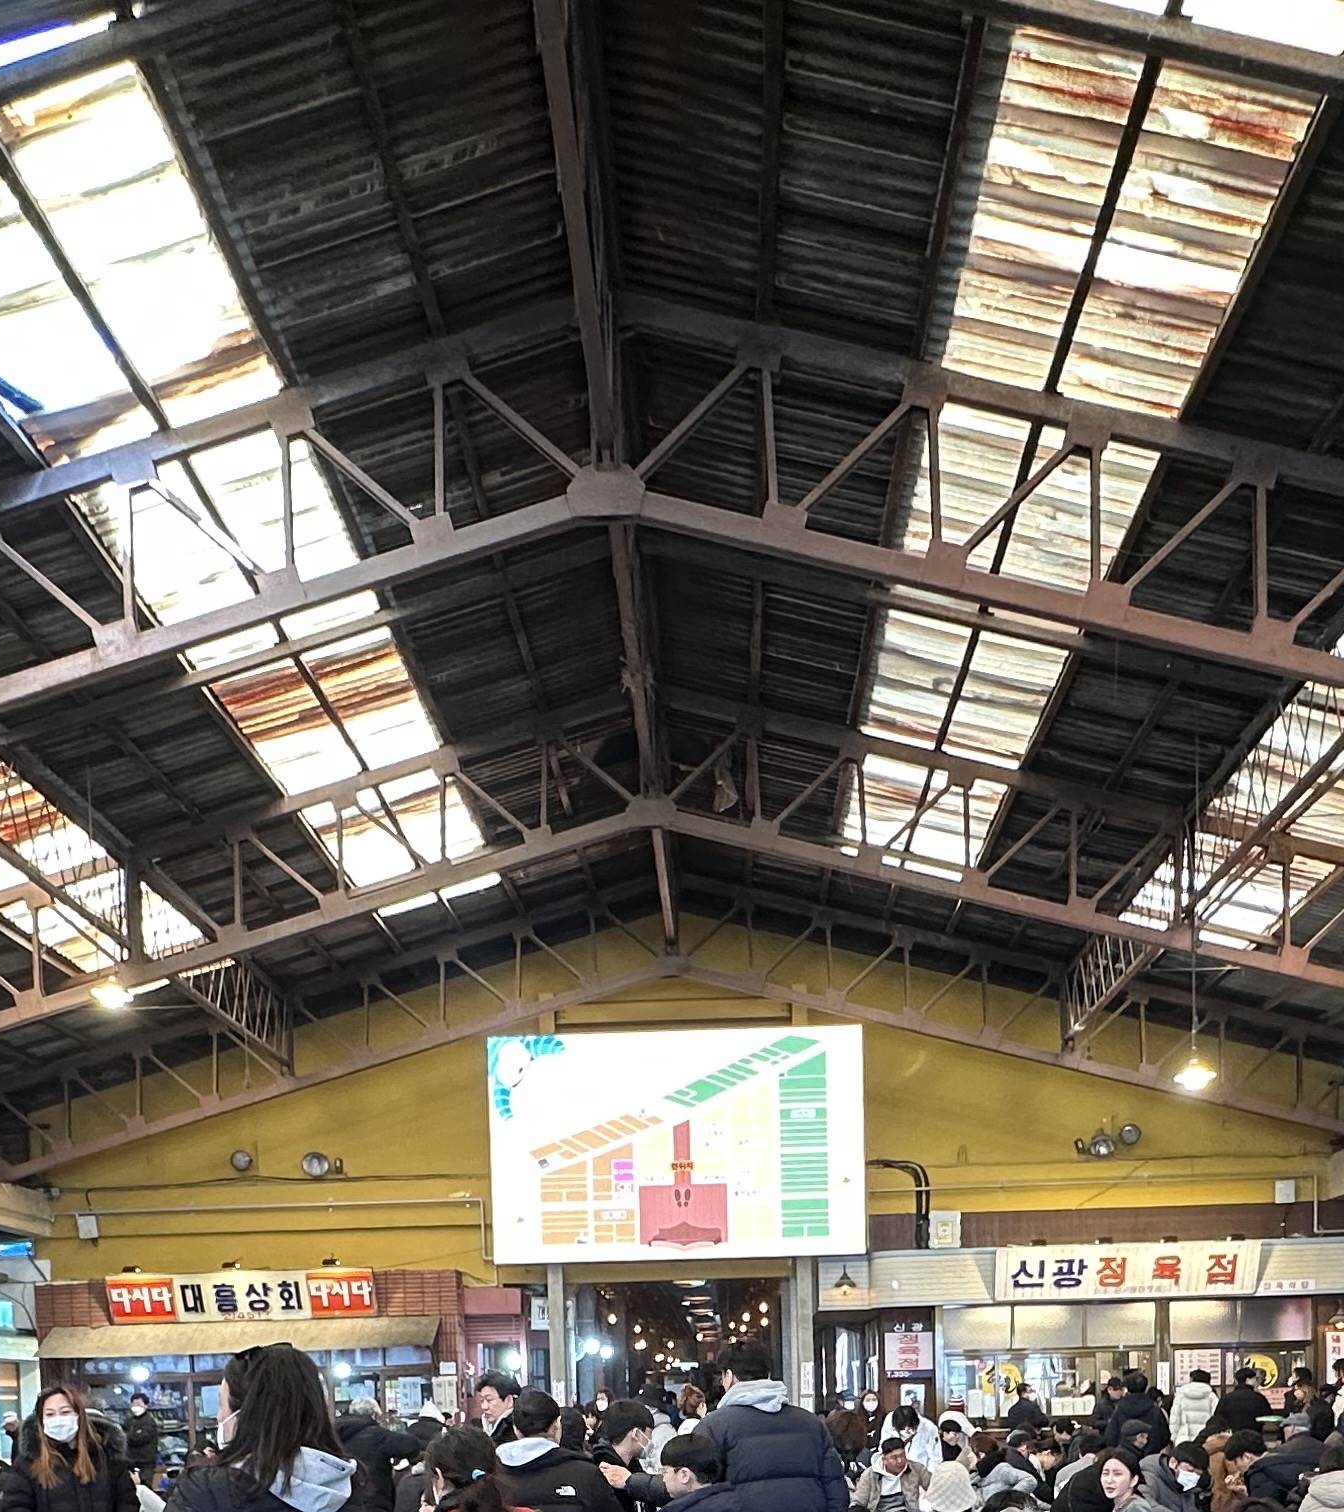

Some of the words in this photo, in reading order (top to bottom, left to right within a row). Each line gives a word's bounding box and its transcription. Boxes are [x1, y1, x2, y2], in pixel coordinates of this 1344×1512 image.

[110, 1286, 173, 1314] 다시다
[179, 1280, 304, 1314] 대흥상회
[308, 1278, 372, 1308] 다시다
